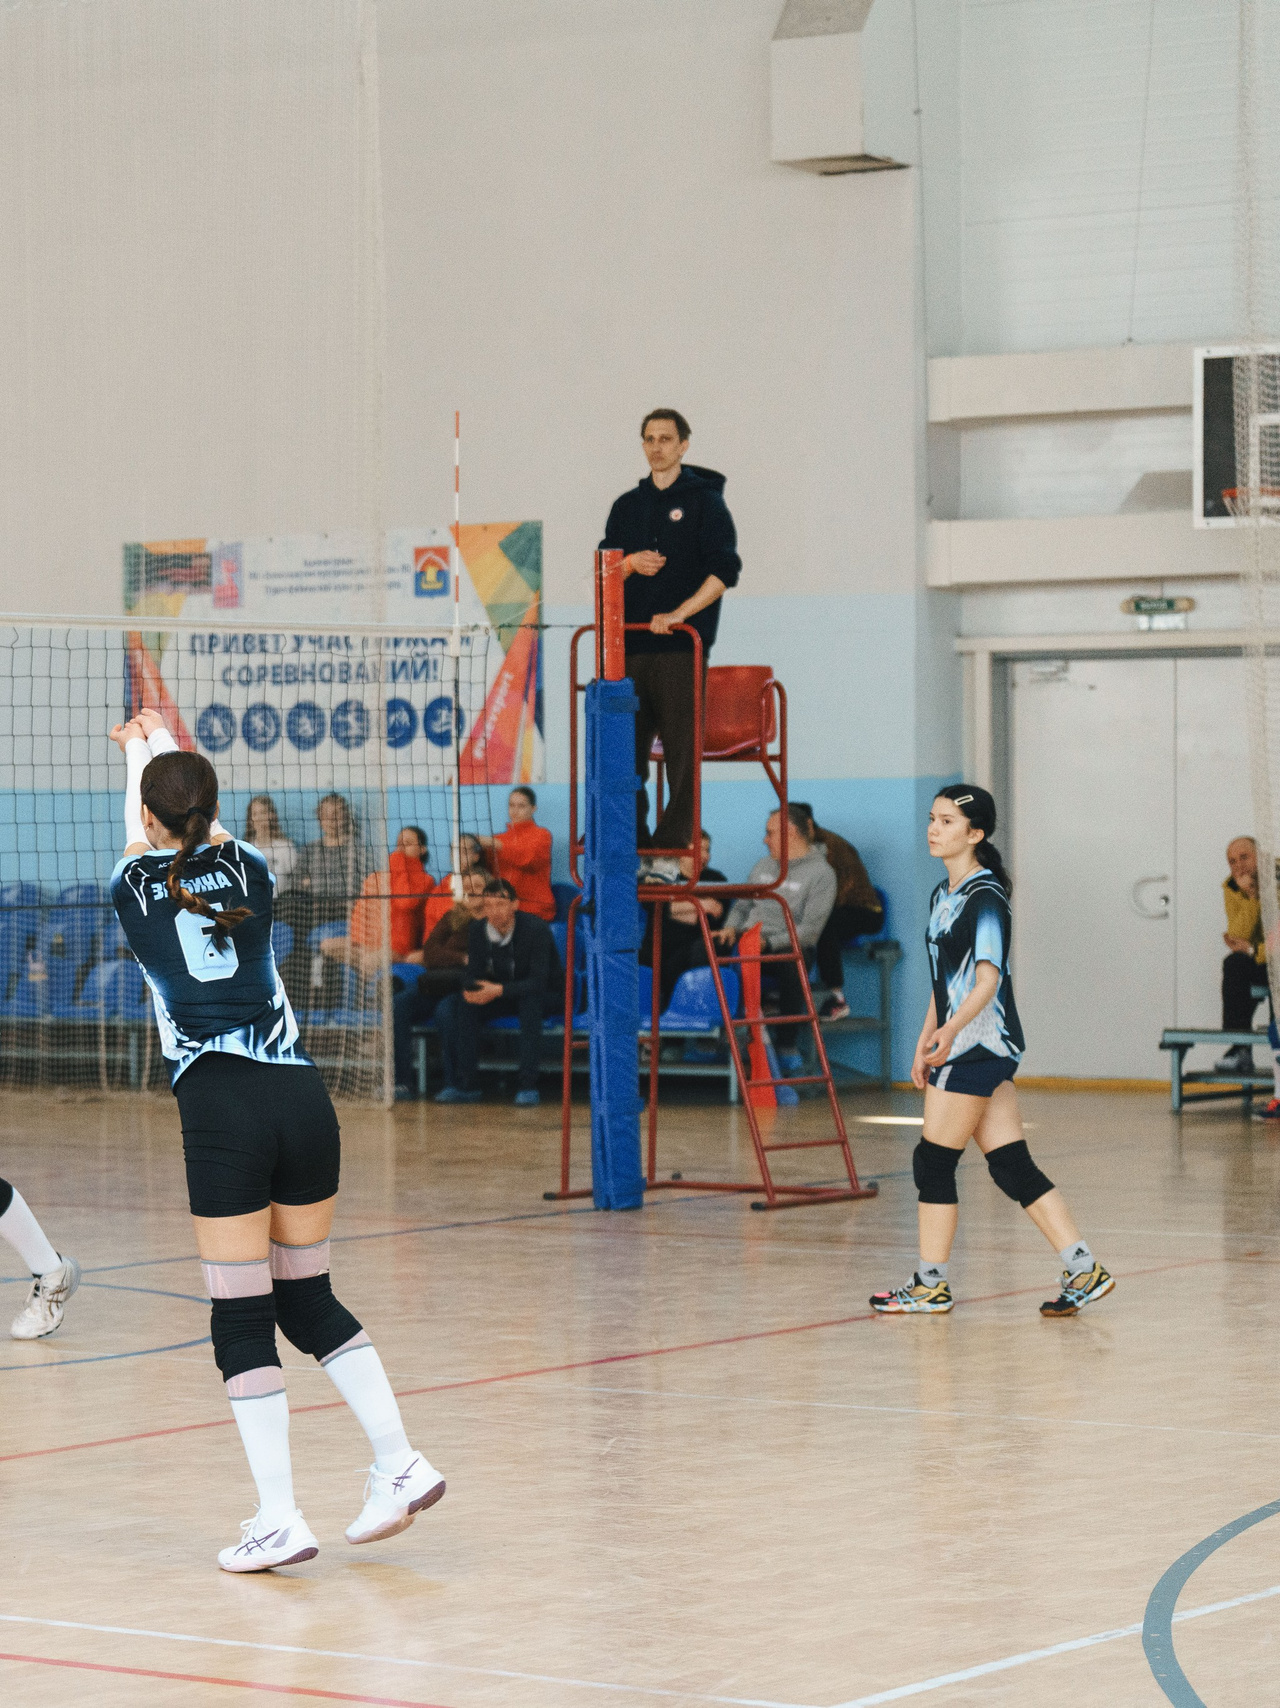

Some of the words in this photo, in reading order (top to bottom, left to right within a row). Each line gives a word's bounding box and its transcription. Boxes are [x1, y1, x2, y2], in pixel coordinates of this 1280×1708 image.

[189, 632, 283, 656] ПРИВЕТ
[292, 633, 470, 653] УЧАСИКА
[174, 901, 240, 983] 6
